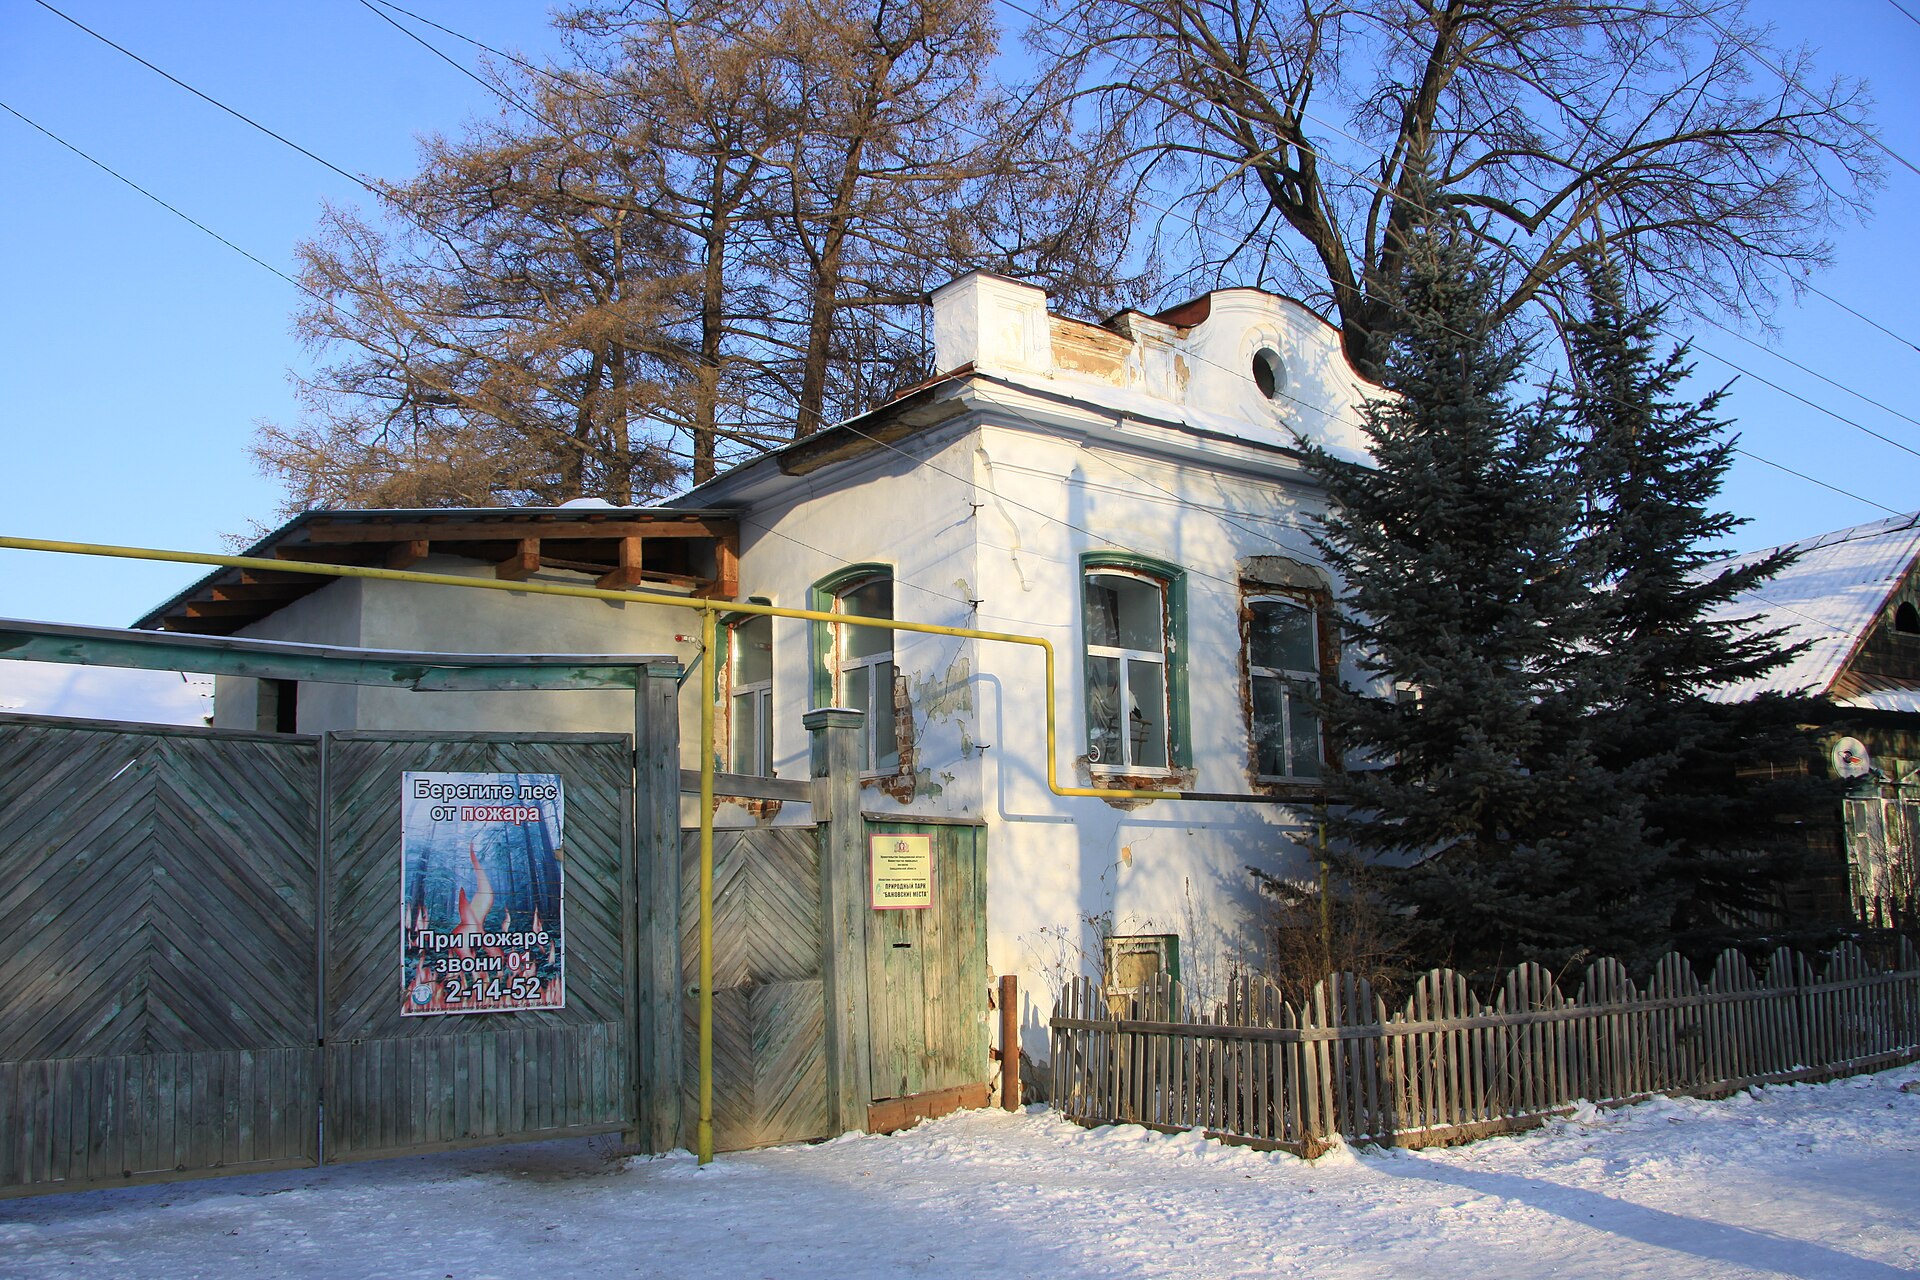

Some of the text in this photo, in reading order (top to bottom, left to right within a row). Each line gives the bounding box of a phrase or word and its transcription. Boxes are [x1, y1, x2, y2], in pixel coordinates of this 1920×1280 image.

[414, 779, 557, 803] Берегите лес
[430, 805, 540, 825] от пожара
[419, 930, 549, 952] При пожаре
[436, 951, 531, 973] звони 01
[445, 977, 541, 1003] 2-14-52
